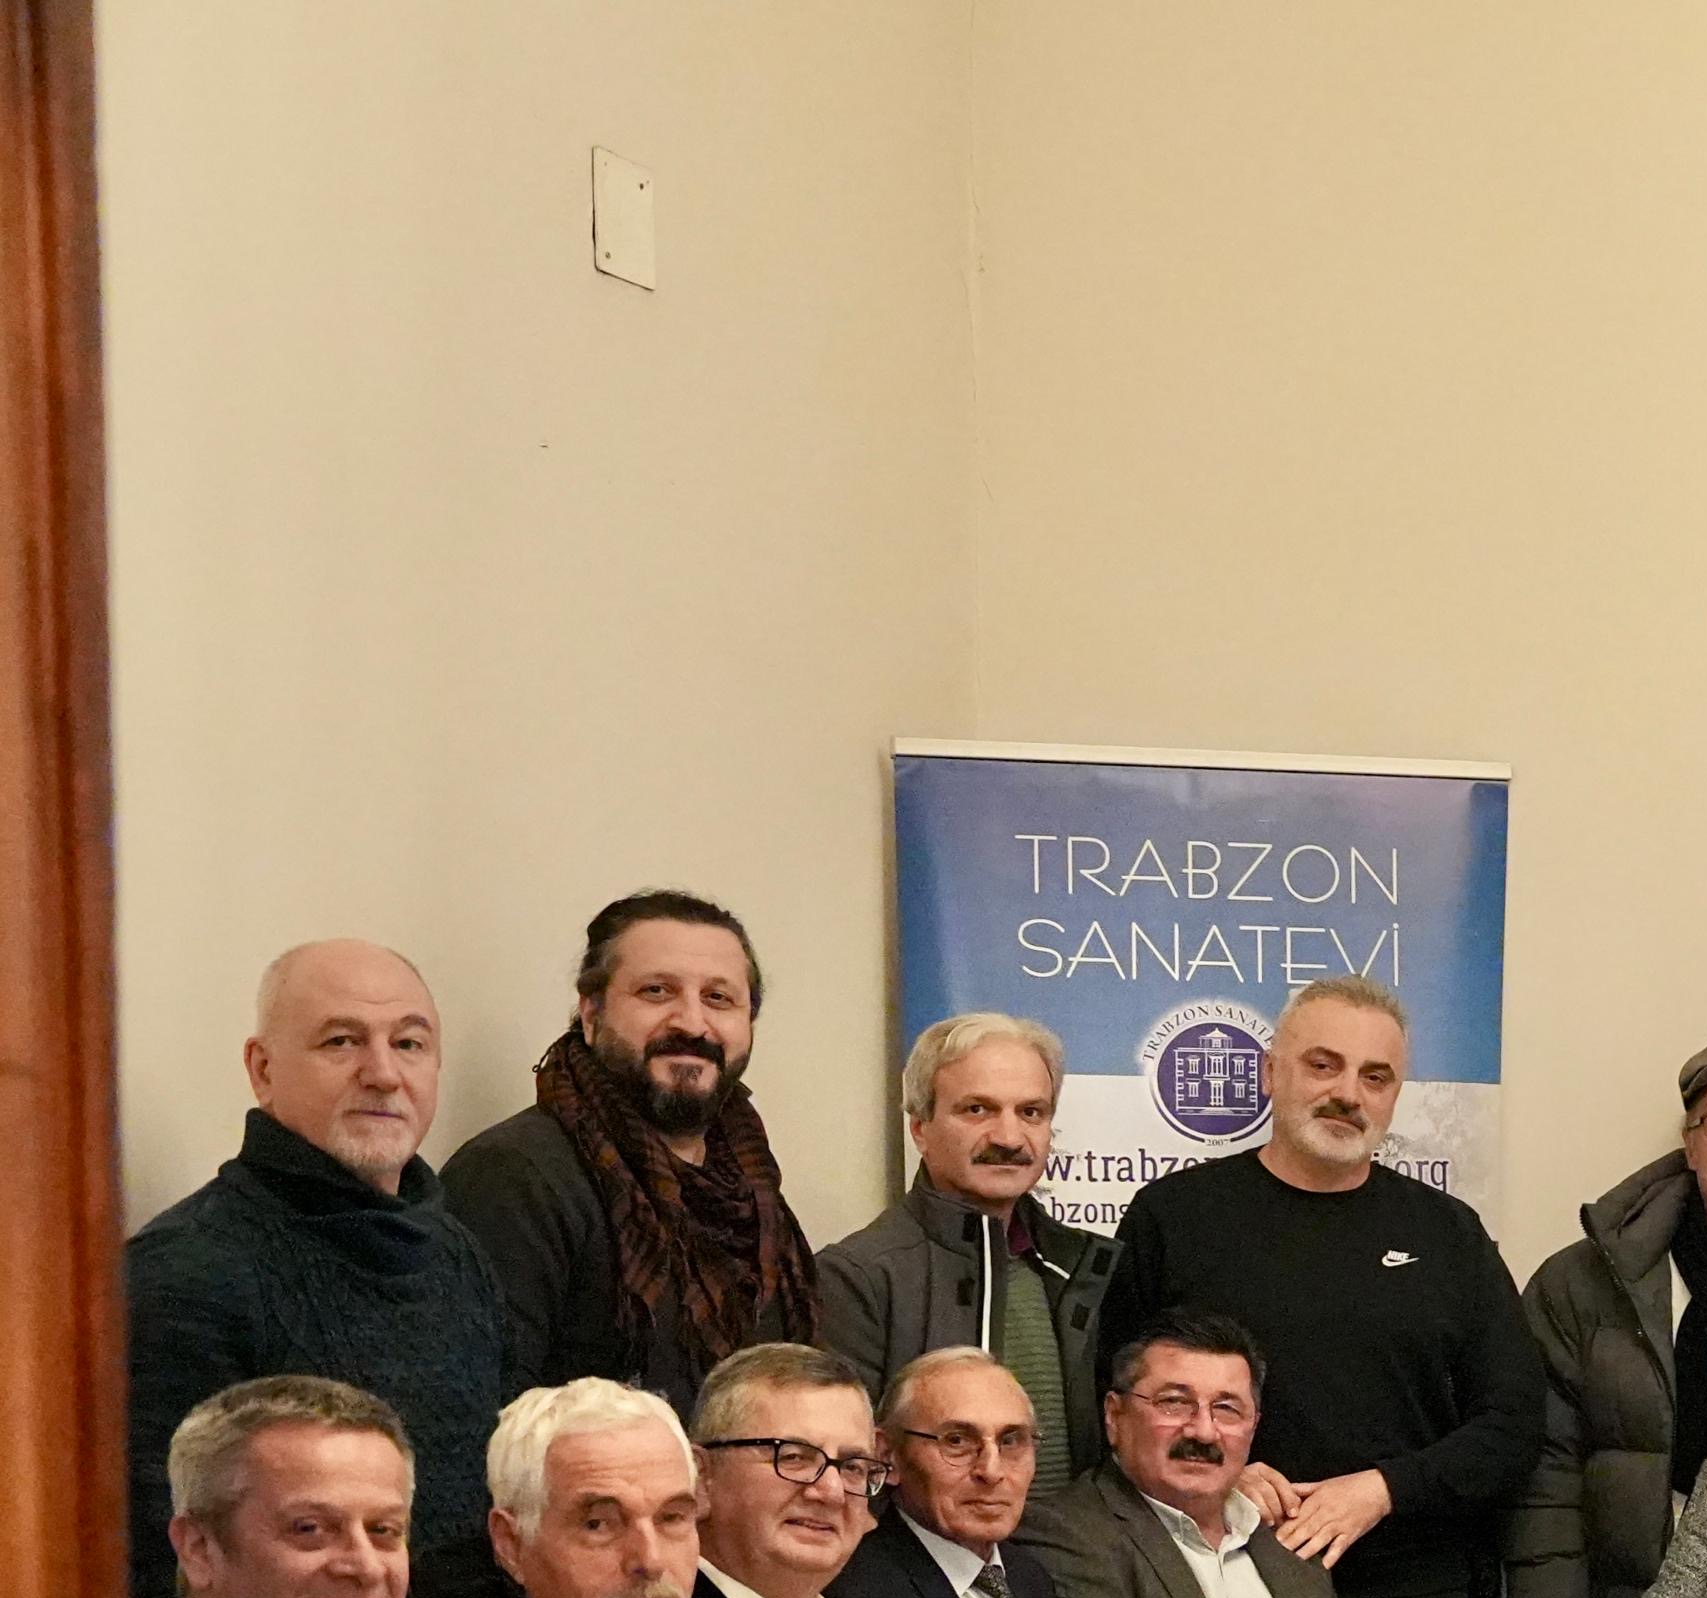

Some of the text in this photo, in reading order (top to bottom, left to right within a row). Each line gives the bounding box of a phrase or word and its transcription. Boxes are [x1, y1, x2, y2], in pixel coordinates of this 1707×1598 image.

[1014, 834, 1398, 906] TRABZON
[1017, 919, 1400, 987] SANATEVİ
[1142, 1004, 1275, 1062] TRABZON SANATE
[1206, 1138, 1230, 1147] 2007
[1386, 1250, 1410, 1261] NIKE
